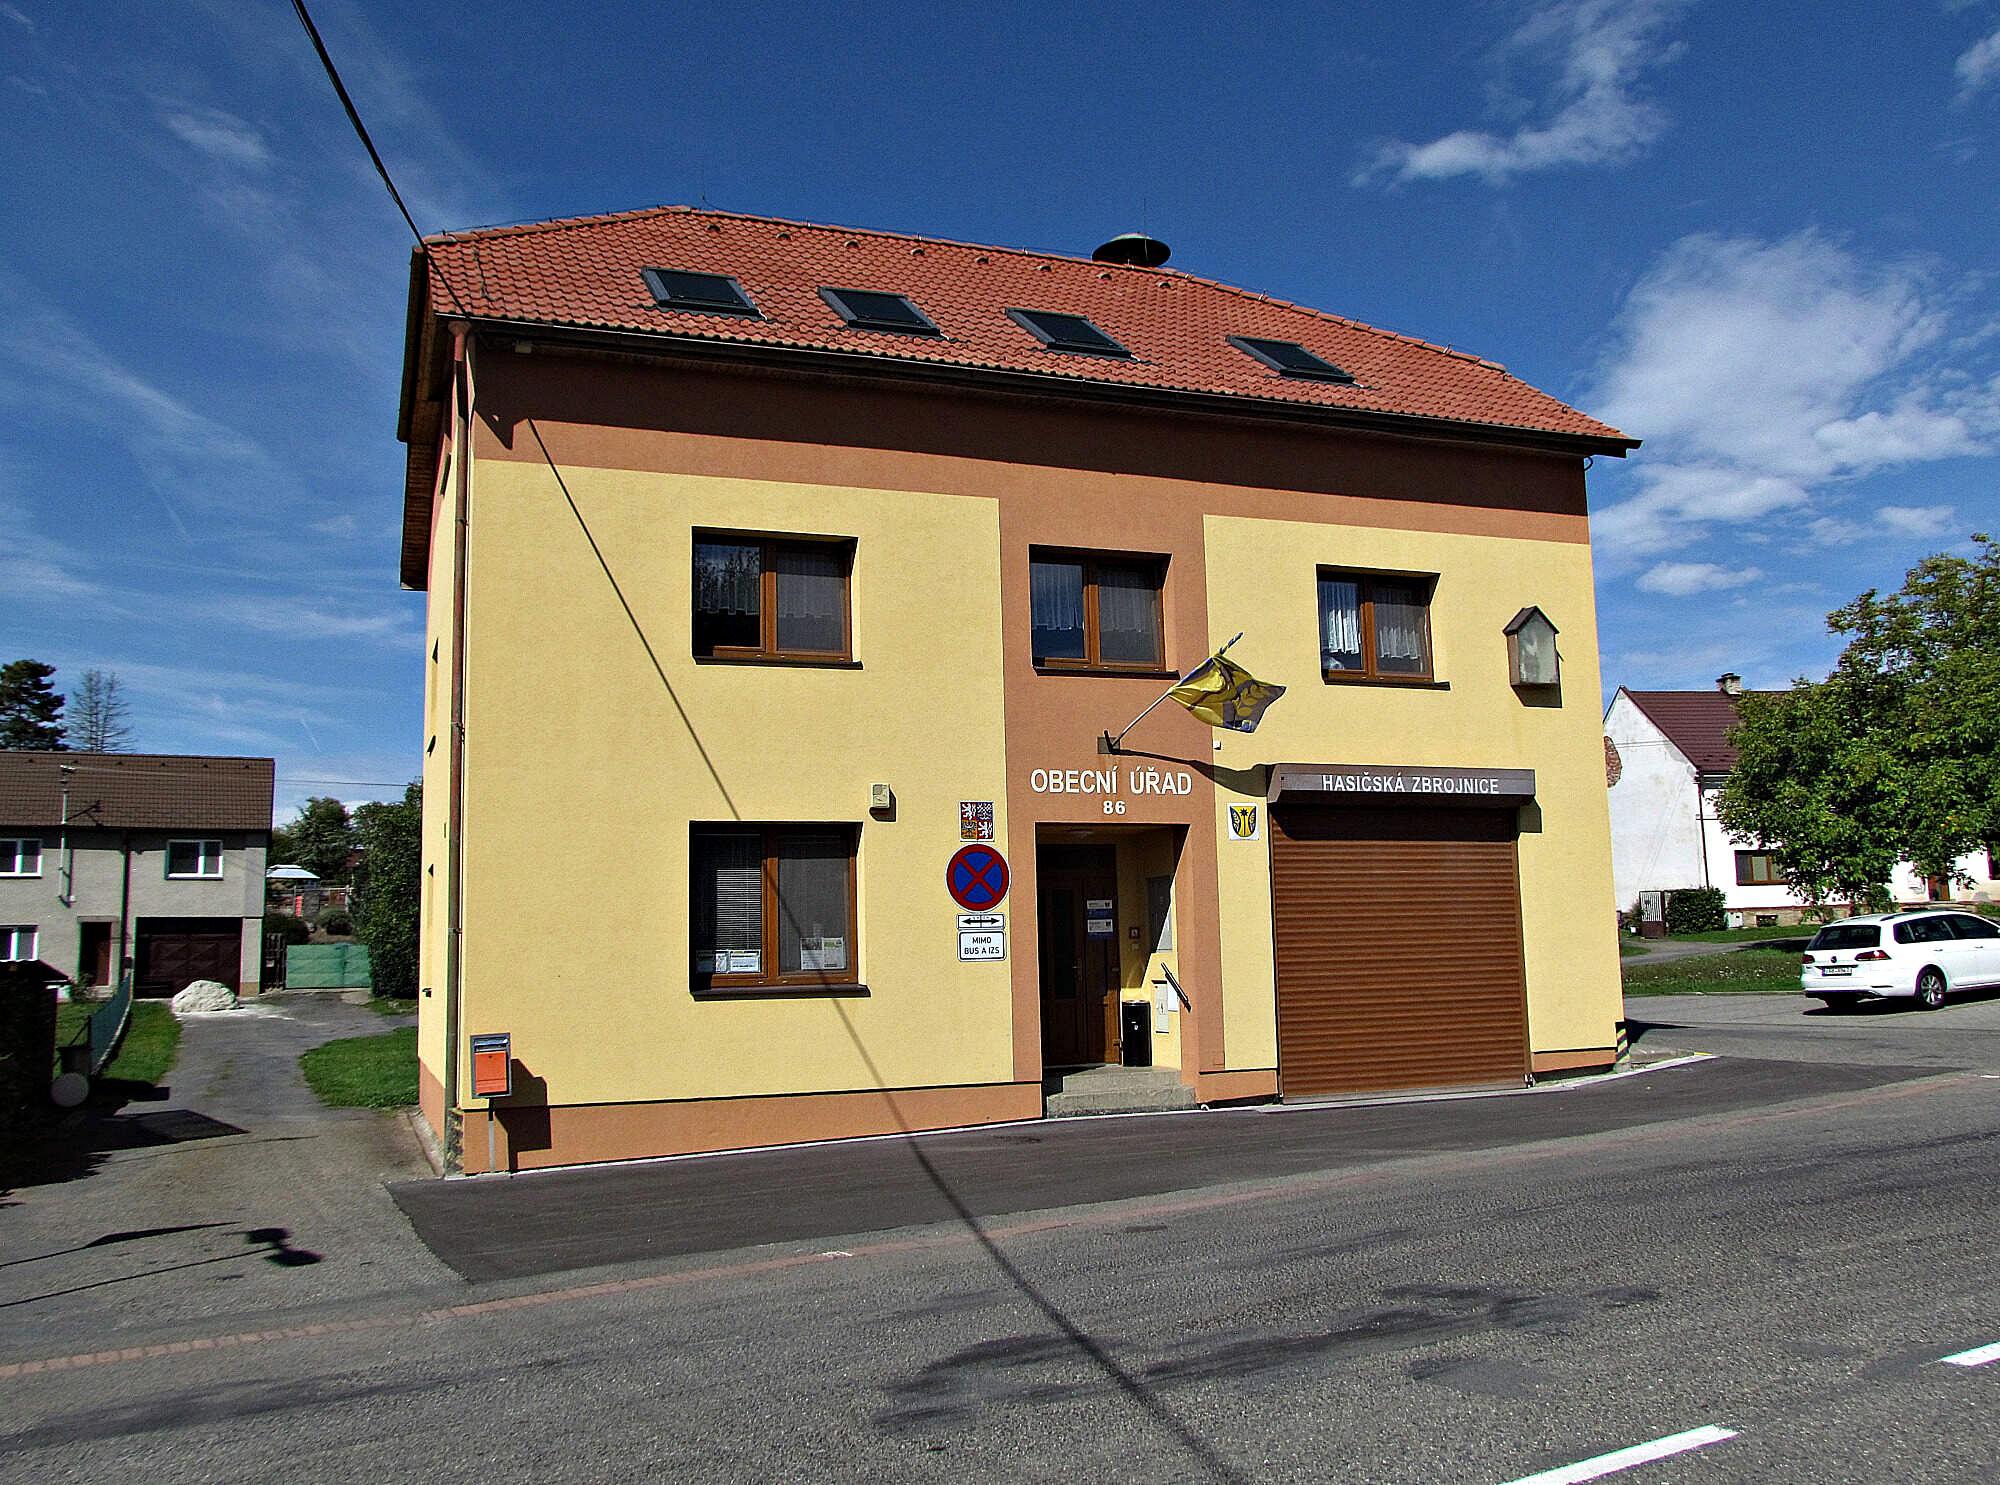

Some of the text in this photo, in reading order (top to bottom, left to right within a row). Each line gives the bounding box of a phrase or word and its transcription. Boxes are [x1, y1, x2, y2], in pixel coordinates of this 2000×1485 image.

[1030, 765, 1192, 795] OBECNÍ ÚŘAD
[1322, 772, 1500, 794] HASIČSKÁ ZBROJNICE
[1103, 800, 1127, 815] 86
[972, 936, 992, 944] MIMO
[964, 947, 980, 955] BUS
